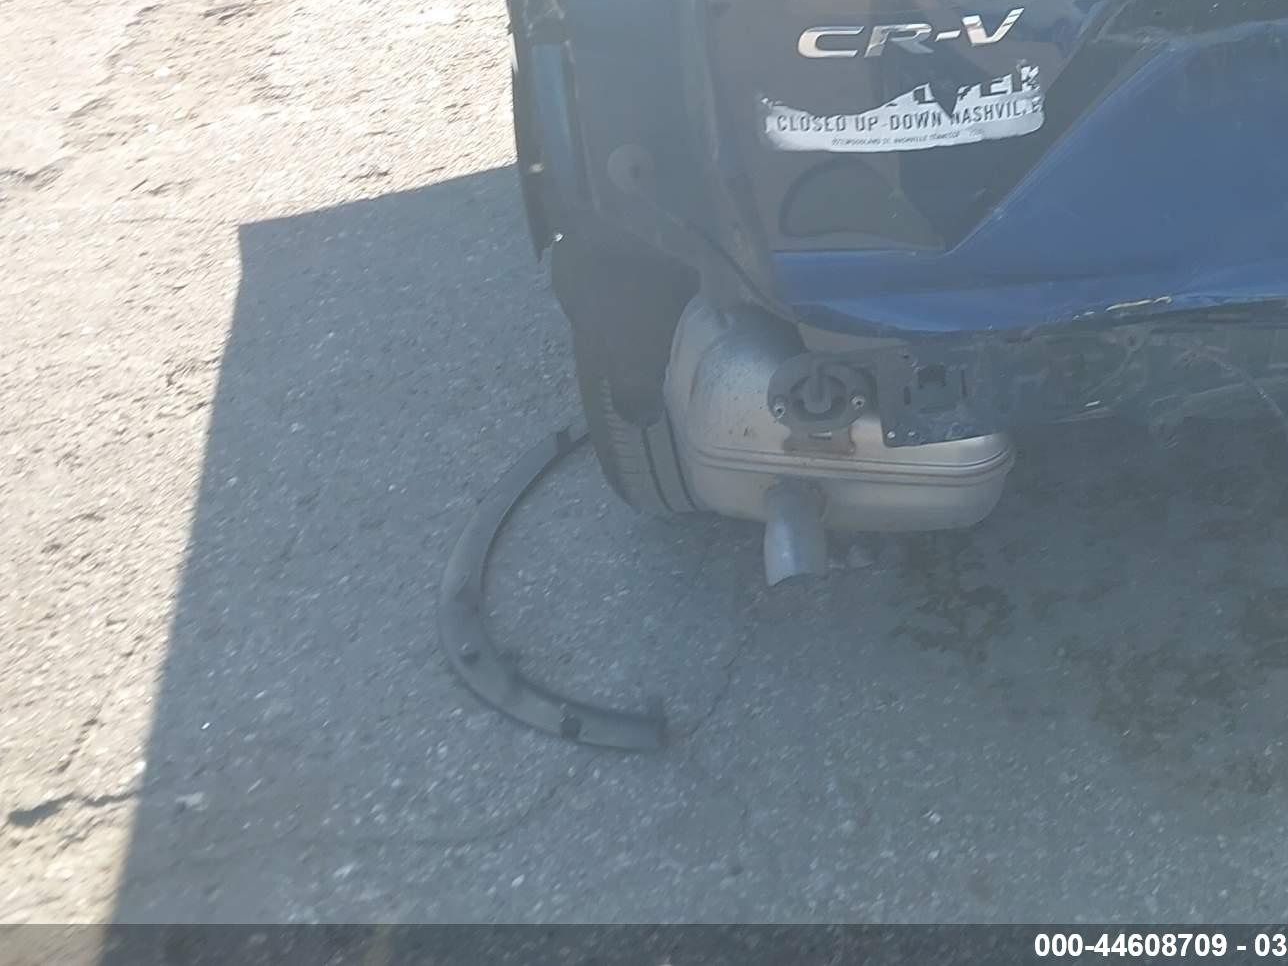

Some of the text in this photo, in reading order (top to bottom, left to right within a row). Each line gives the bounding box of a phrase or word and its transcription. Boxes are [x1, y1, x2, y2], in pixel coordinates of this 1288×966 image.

[797, 7, 1025, 58] CR-V
[777, 114, 846, 132] CLOSED
[950, 96, 1042, 125] NASHVILE
